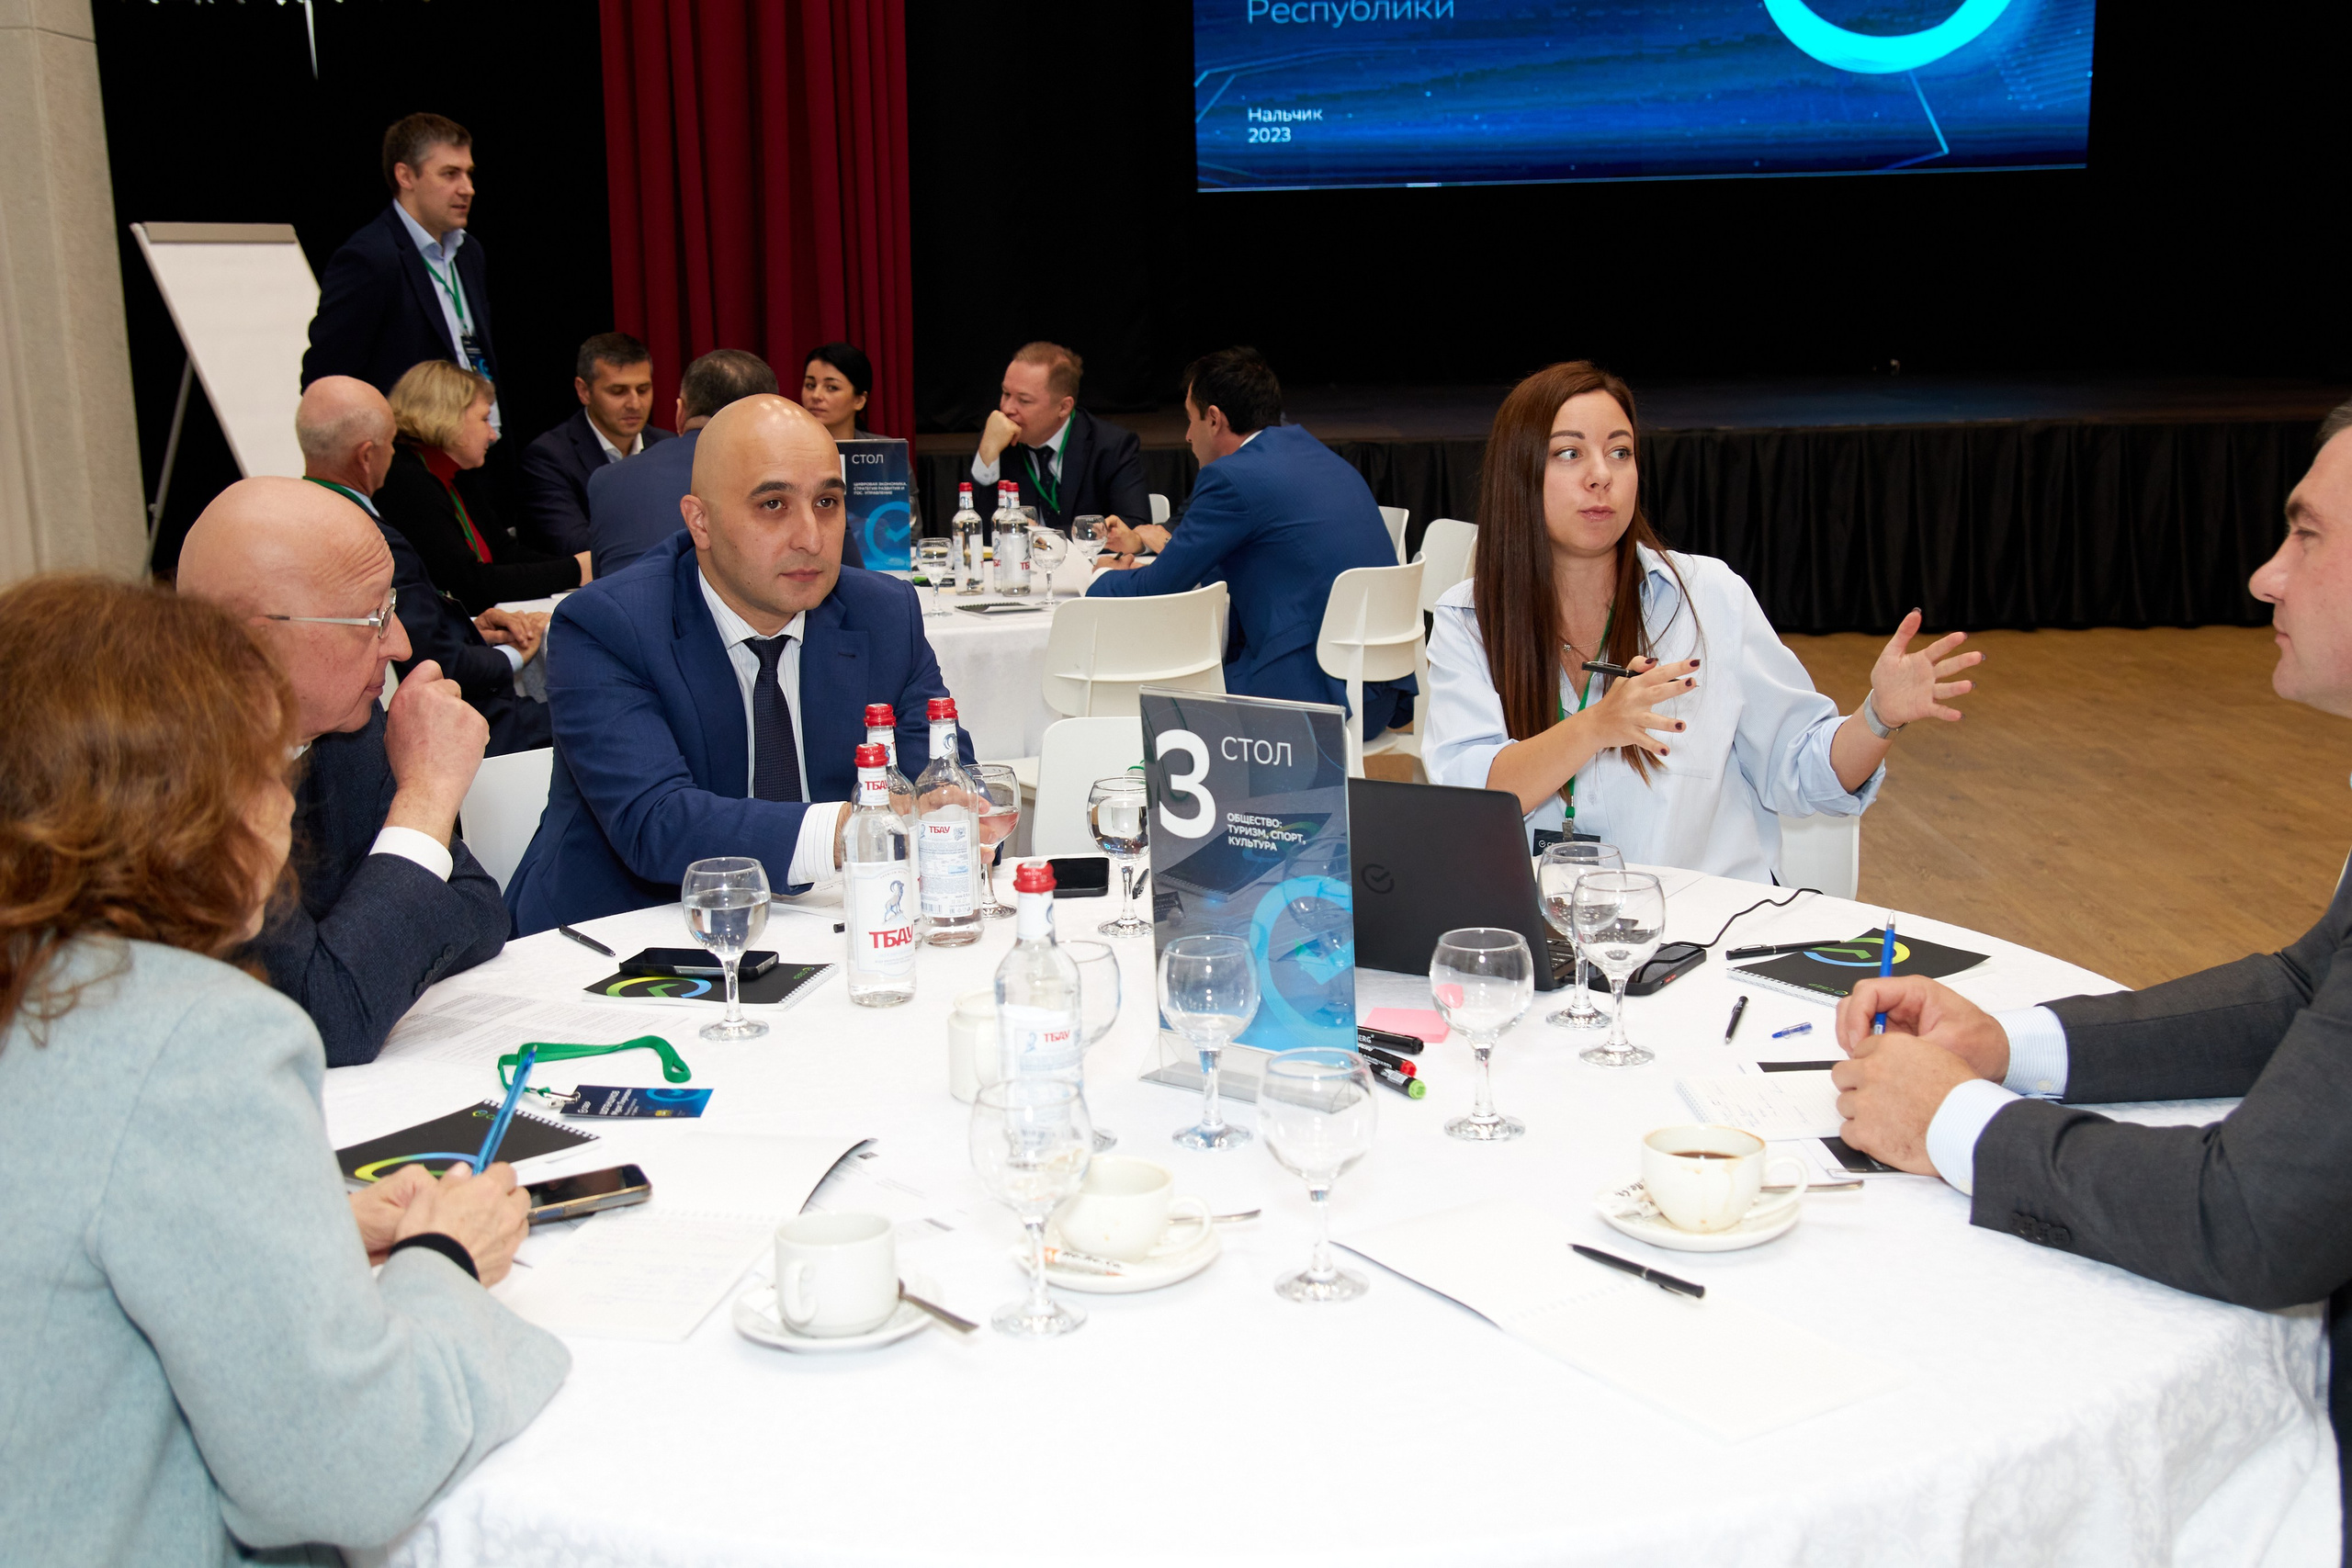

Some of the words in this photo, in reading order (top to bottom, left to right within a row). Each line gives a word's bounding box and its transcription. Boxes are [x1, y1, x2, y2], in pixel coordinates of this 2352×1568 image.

[1247, 0, 1454, 28] Республики
[1247, 107, 1323, 122] Нальчик
[1247, 126, 1292, 143] 2023
[852, 454, 884, 464] СТОЛ
[1220, 736, 1293, 767] СТОЛ
[1155, 728, 1216, 840] 3
[1227, 812, 1283, 829] ОБЩЕСТВО:
[929, 825, 950, 834] ТБАУ
[1227, 824, 1269, 840] ТУРИЗМ,
[1270, 829, 1306, 845] СПОРТ,
[1227, 836, 1278, 852] КУЛЬТУРА
